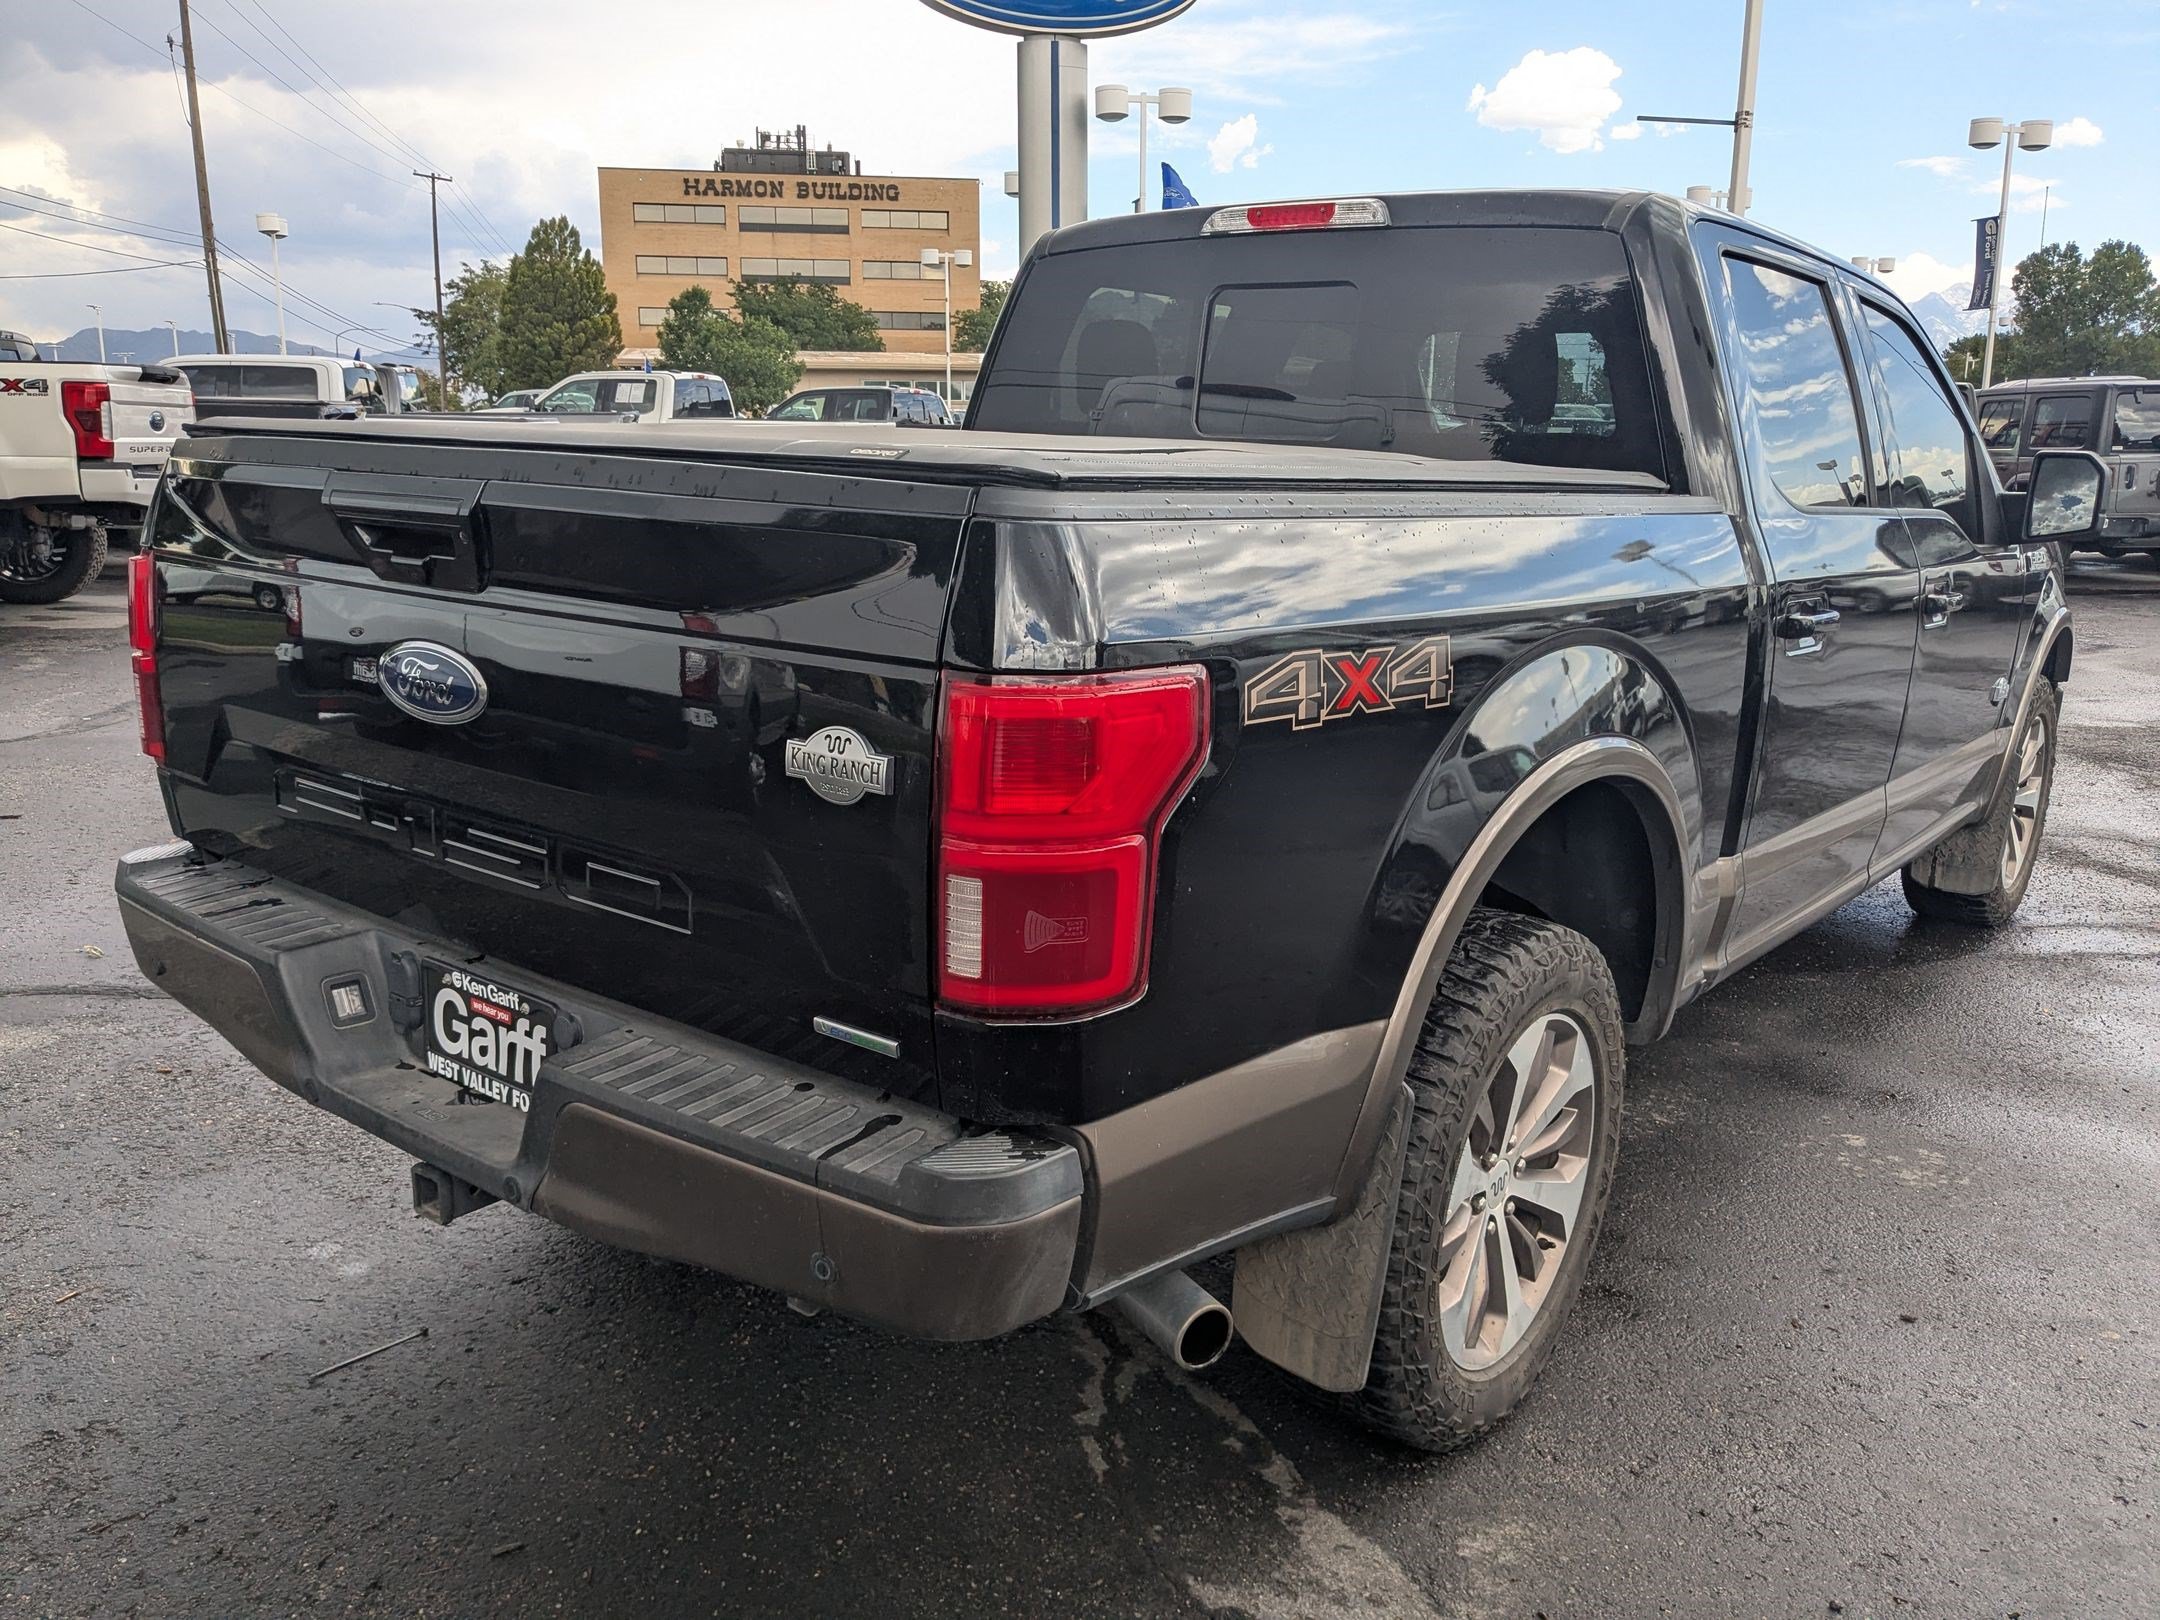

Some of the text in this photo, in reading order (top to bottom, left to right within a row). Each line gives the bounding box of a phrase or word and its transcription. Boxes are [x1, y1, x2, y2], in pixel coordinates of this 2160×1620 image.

[683, 178, 900, 201] HARMON BUILDING
[0, 378, 48, 393] X4
[397, 656, 454, 705] Ford
[1244, 636, 1454, 731] 4X4
[791, 746, 881, 785] KING RANCH
[462, 973, 487, 998] Ken
[487, 984, 519, 1010] Garff
[473, 1001, 509, 1021] we hear you
[434, 988, 547, 1087] Garff
[428, 1051, 530, 1113] WEST VALLEY FO
